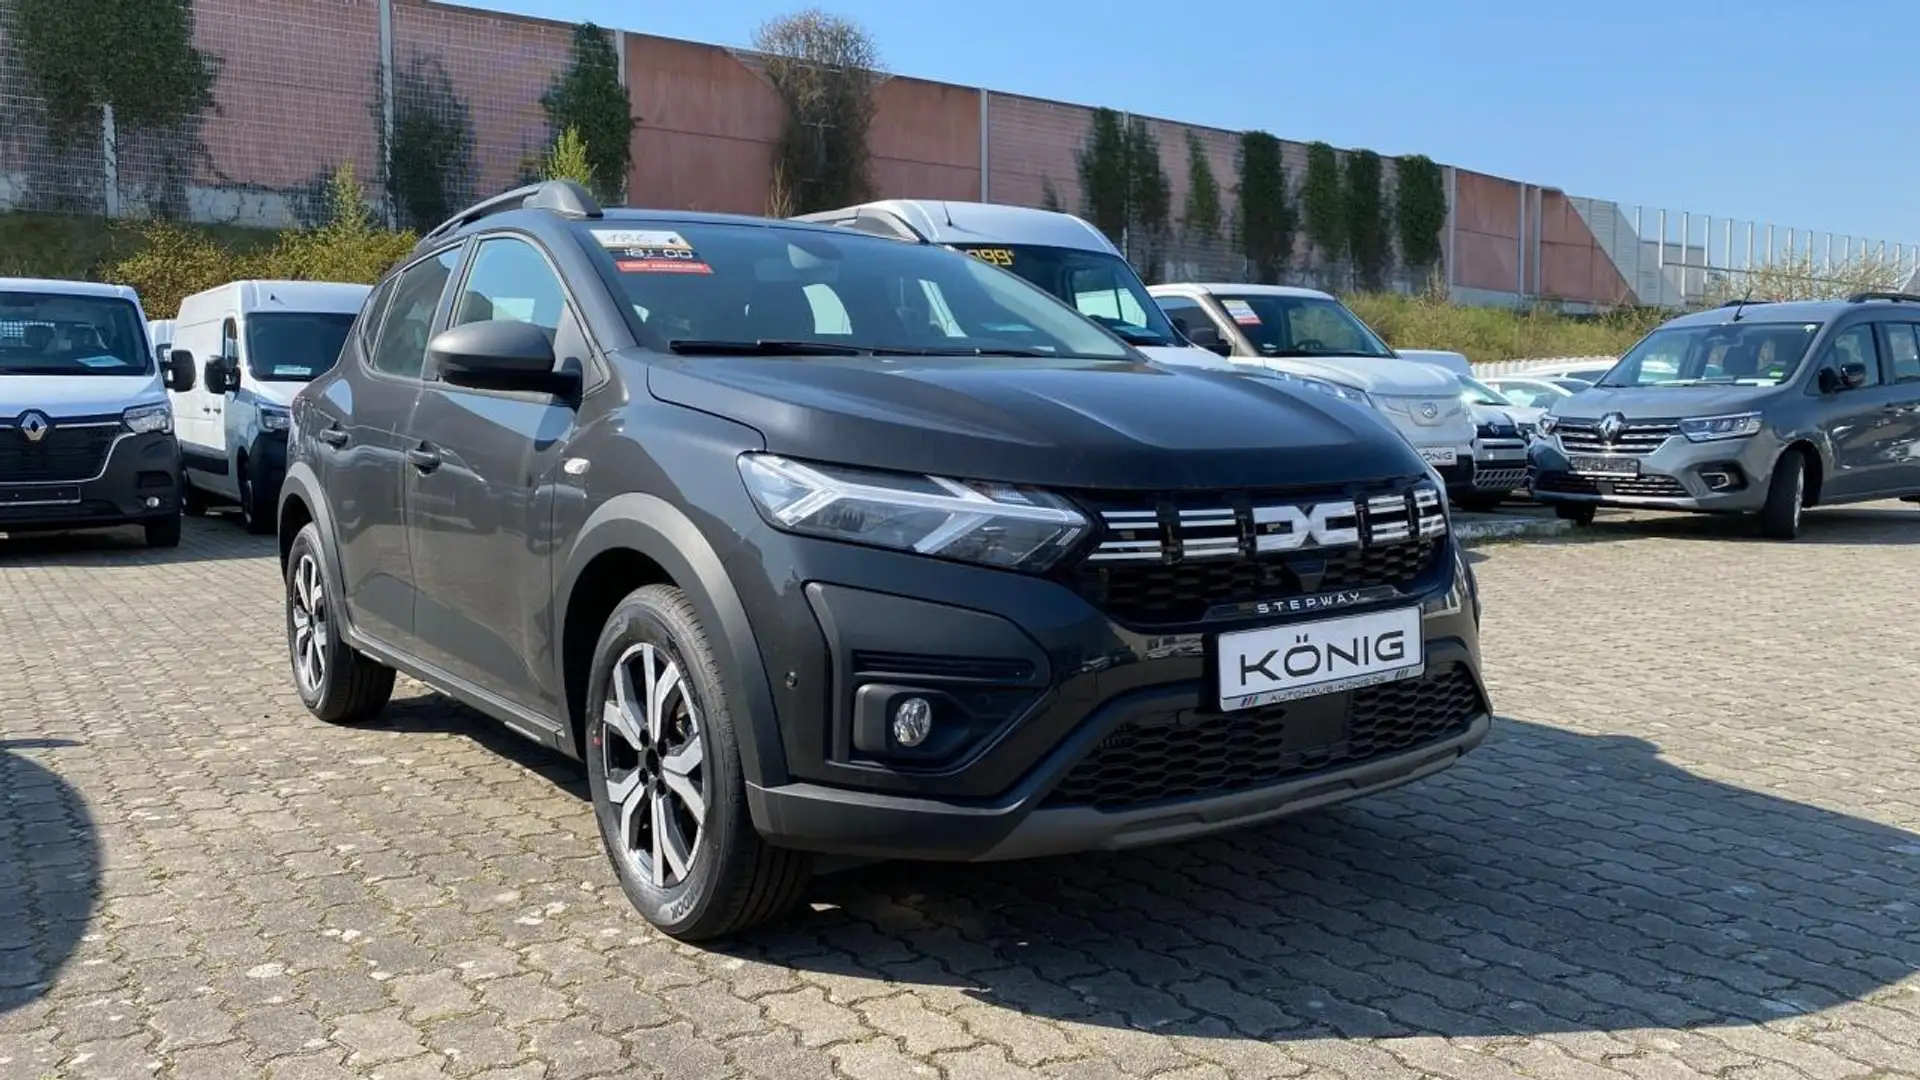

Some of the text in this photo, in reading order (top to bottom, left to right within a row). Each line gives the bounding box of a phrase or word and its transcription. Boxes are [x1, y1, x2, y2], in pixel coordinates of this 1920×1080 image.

[1422, 450, 1453, 461] ÖNIG
[1257, 592, 1360, 613] STEPWAY
[1240, 630, 1405, 686] KÖNIG
